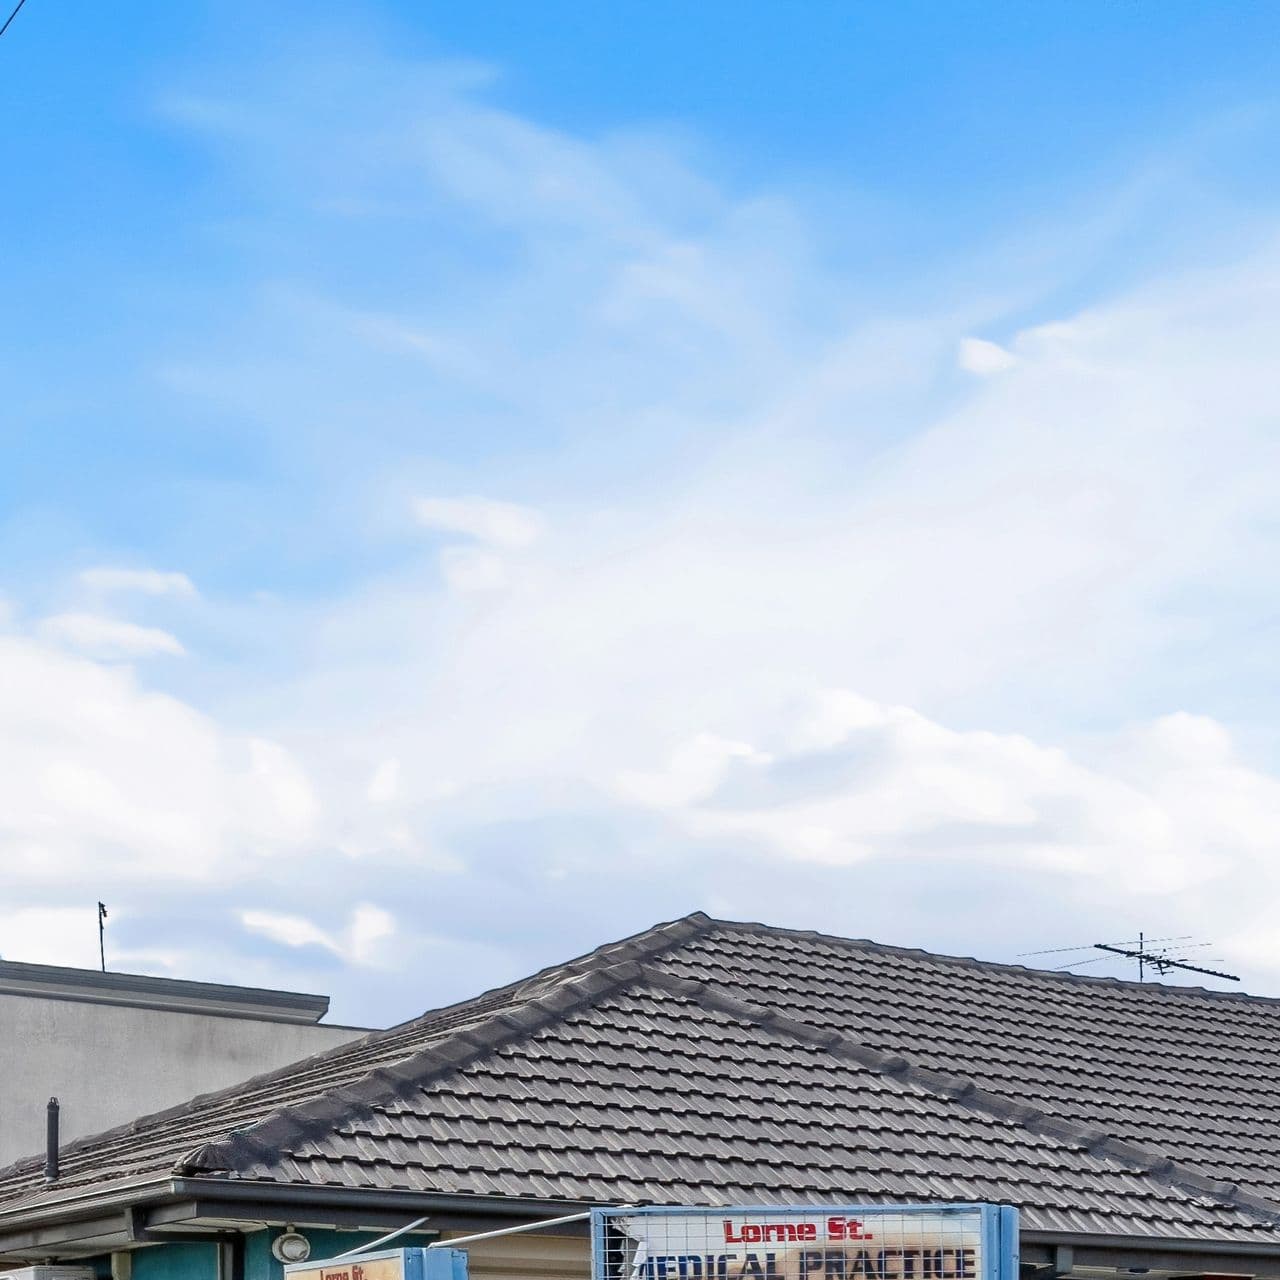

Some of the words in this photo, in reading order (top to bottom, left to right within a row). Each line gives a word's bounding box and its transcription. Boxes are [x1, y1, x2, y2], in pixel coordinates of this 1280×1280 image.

[724, 1220, 816, 1243] Lorne
[827, 1217, 873, 1240] St.
[799, 1249, 976, 1280] PRACTICE
